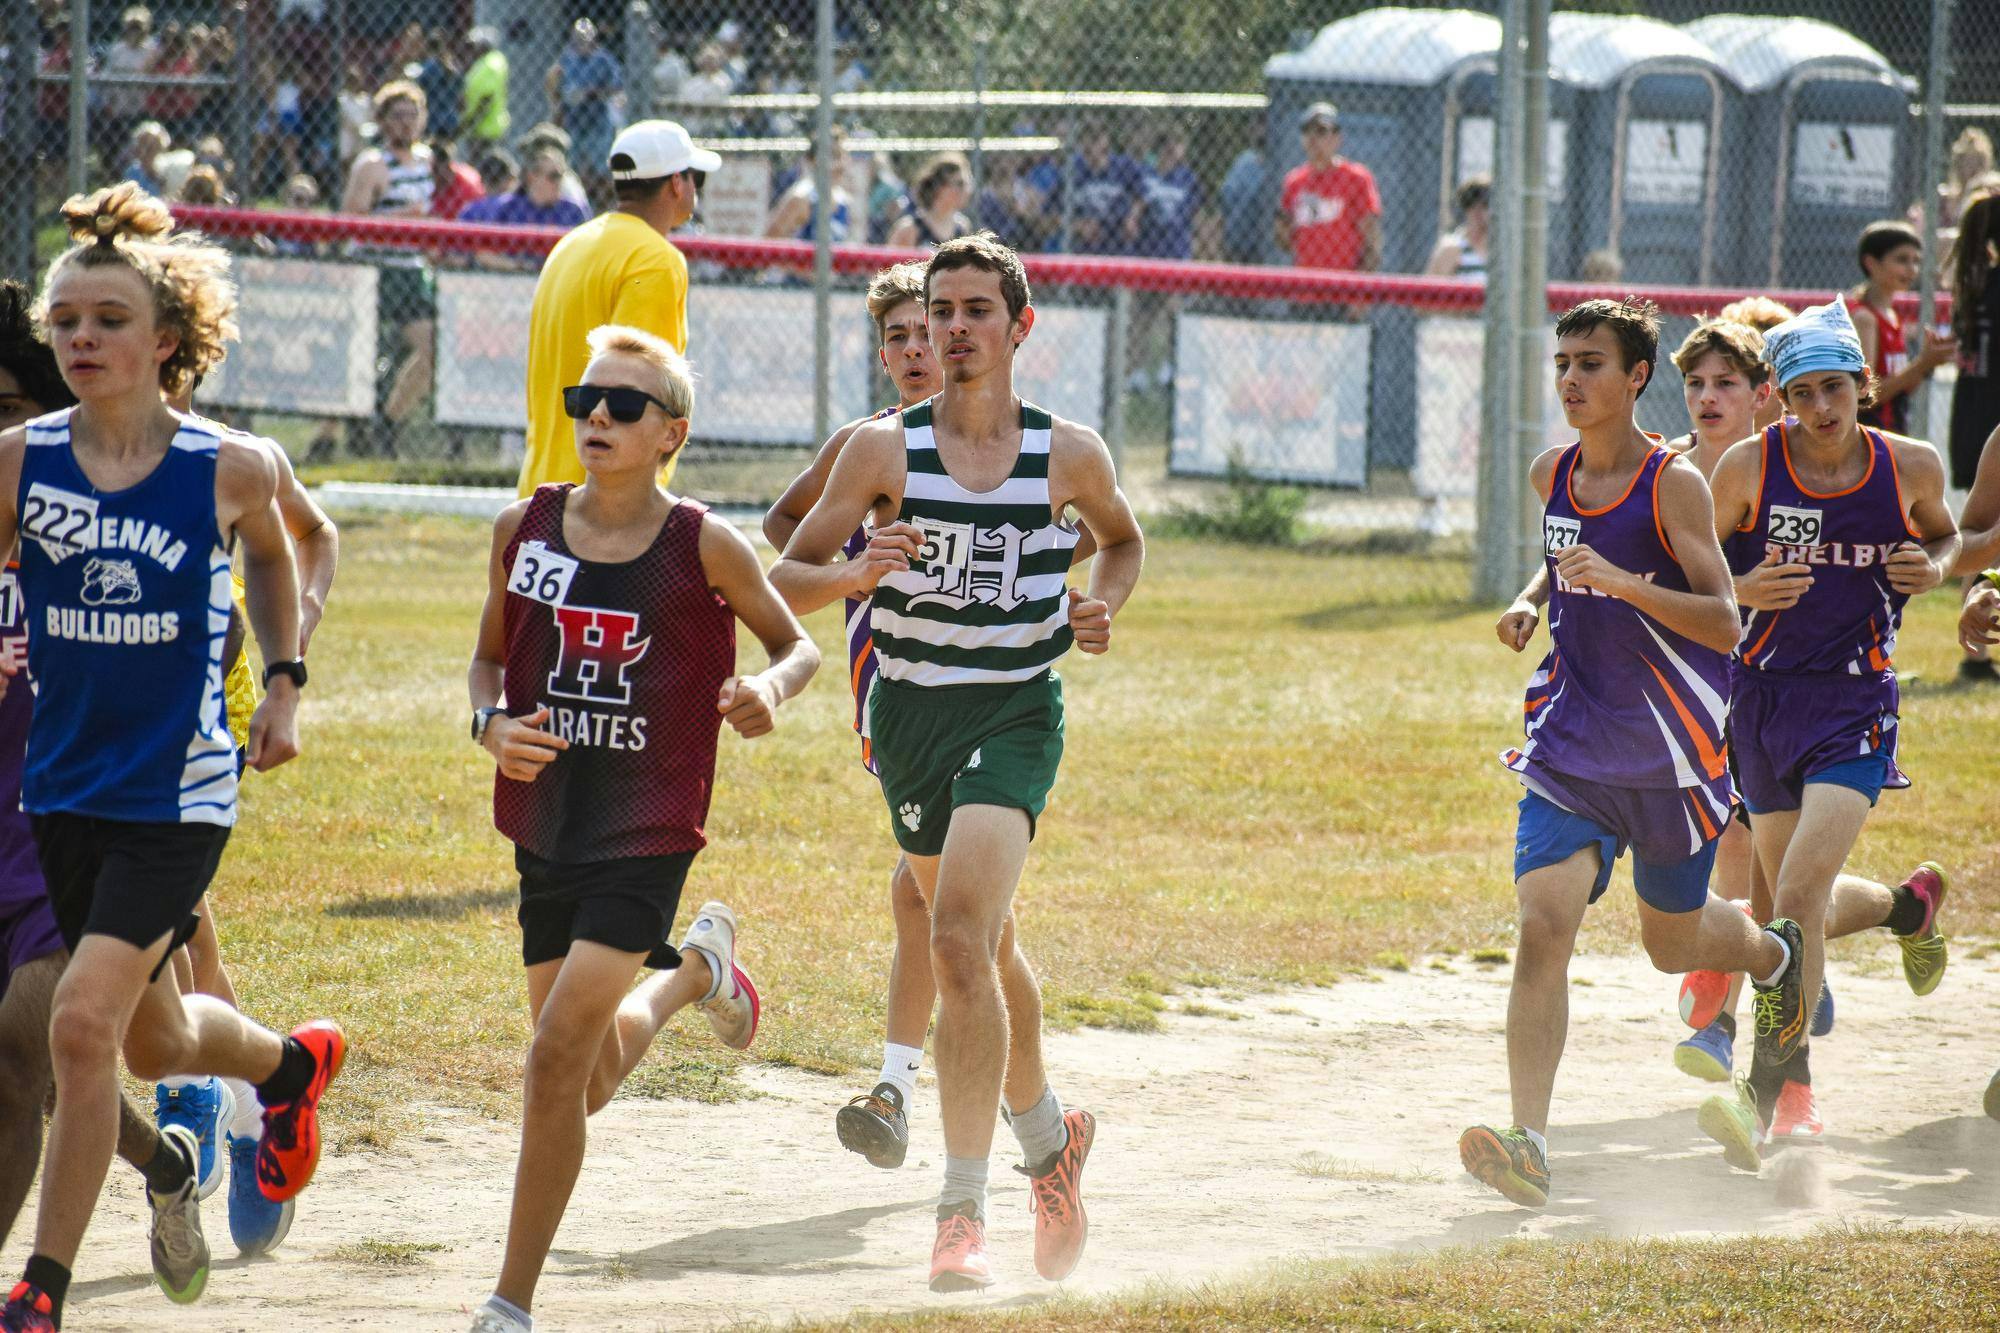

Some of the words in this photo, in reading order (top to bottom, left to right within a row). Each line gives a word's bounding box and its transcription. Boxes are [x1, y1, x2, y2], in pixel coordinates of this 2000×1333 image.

[23, 496, 91, 549] 222
[1547, 524, 1578, 555] 237
[1768, 513, 1820, 544] 239
[919, 528, 957, 566] 51
[516, 557, 563, 601] 36
[0, 584, 11, 626] 1
[46, 605, 179, 645] BULLDOGS
[547, 604, 652, 705] H
